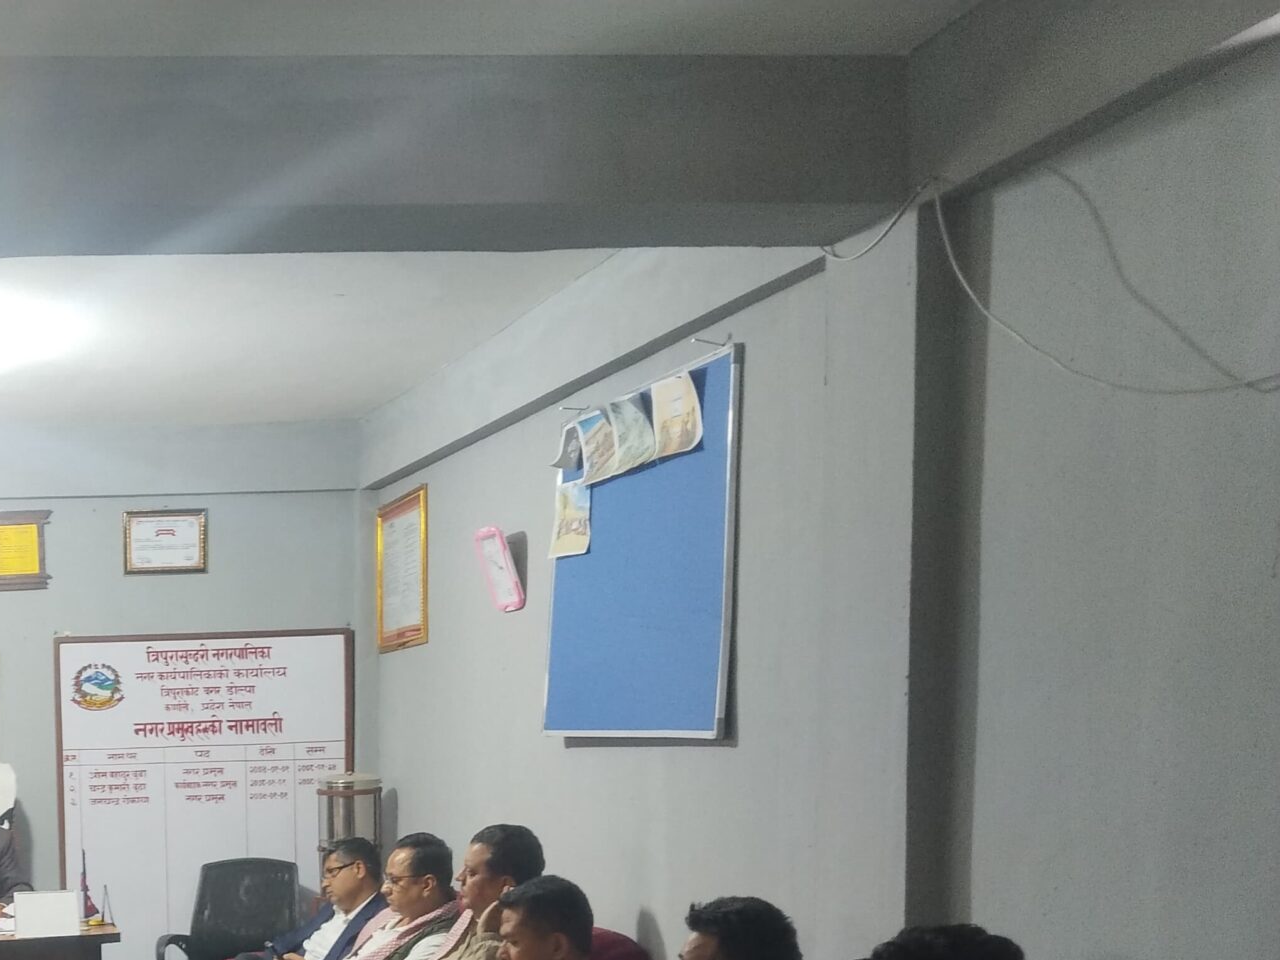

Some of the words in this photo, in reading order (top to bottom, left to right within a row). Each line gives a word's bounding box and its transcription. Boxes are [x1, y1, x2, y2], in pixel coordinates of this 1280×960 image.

[211, 643, 272, 663] नगरपालिका
[135, 672, 155, 682] नगर
[157, 666, 229, 681] कार्यपालिकाको
[233, 664, 288, 679] कार्यालय
[226, 682, 256, 696] डोल्पा
[201, 699, 225, 711] प्रदेश
[228, 699, 253, 711] नेपाल
[133, 723, 164, 738] नगर
[226, 712, 283, 737] नामावली
[194, 750, 211, 758] पद
